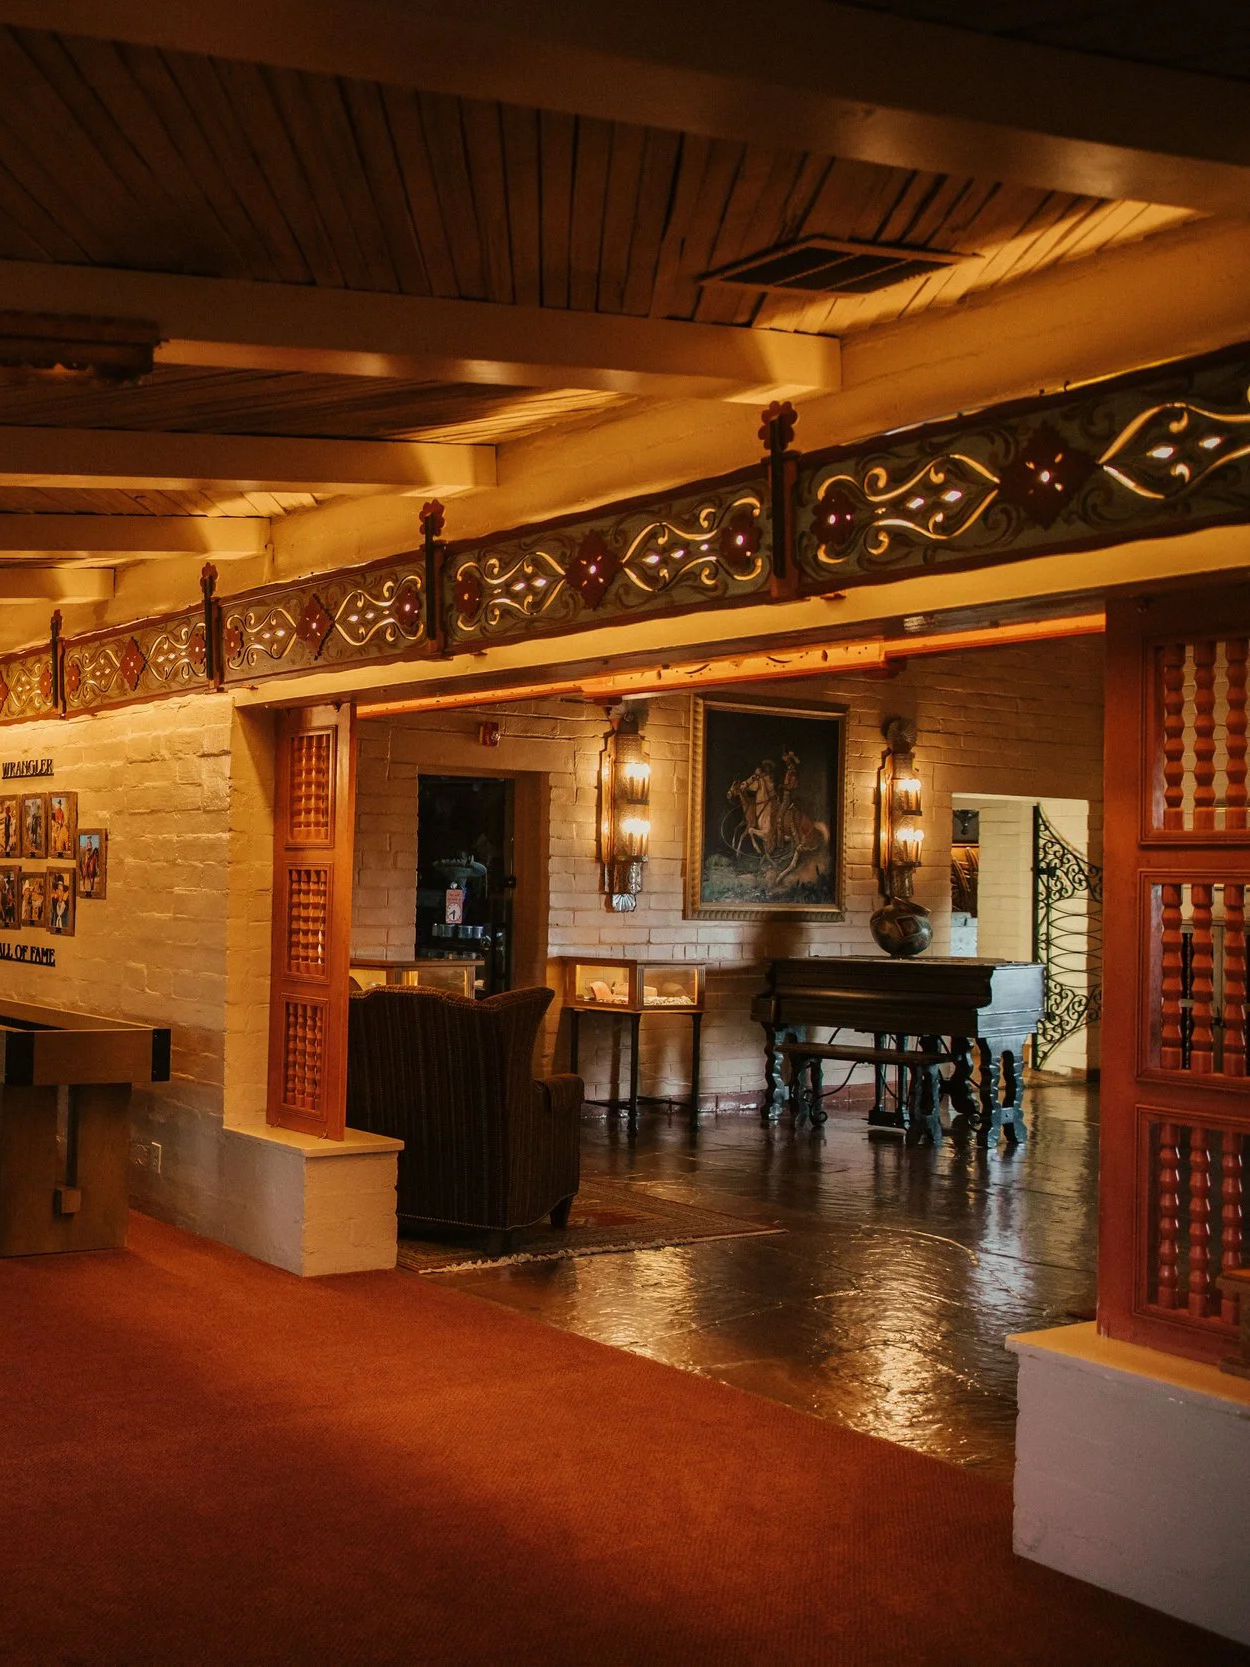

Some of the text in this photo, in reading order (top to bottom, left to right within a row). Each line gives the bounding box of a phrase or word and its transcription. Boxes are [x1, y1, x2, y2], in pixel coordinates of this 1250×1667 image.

[2, 759, 54, 778] WRANGLER
[14, 944, 29, 962] OF
[30, 946, 55, 967] FAME
